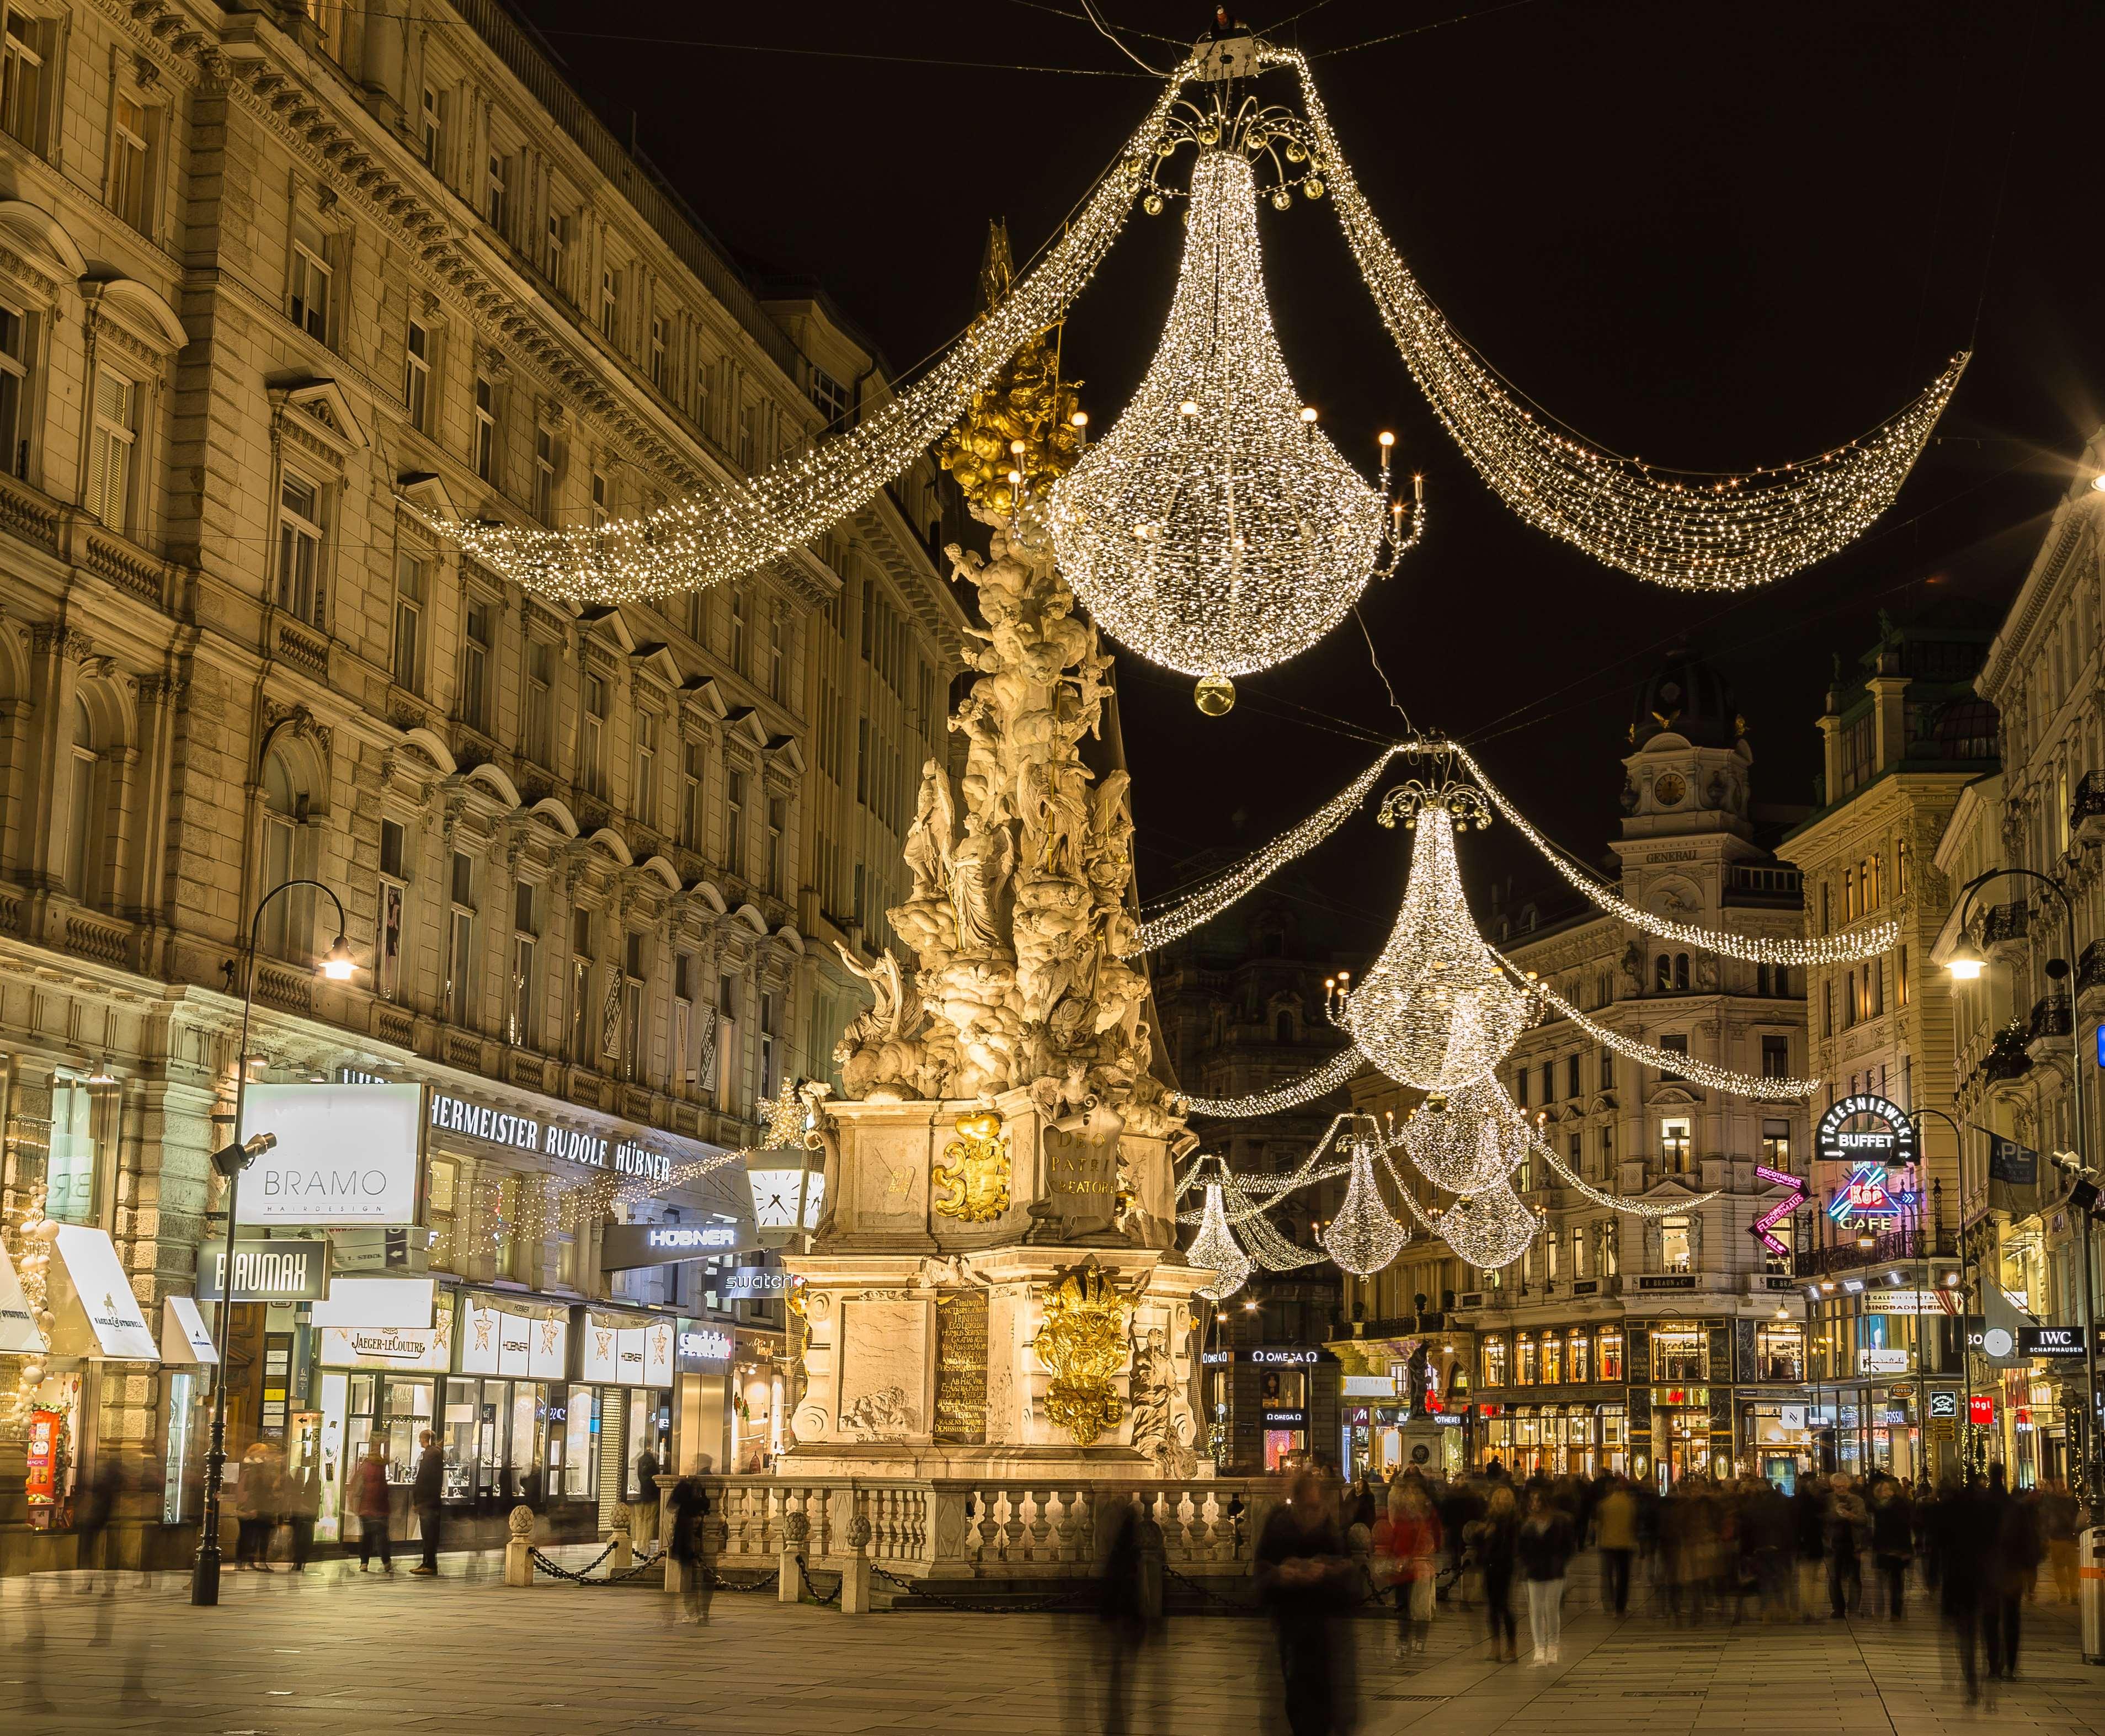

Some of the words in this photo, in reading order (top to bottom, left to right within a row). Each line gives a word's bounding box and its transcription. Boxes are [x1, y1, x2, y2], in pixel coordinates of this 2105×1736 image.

[1646, 850, 1697, 864] GENERALI
[1058, 1131, 1105, 1148] DEO
[1838, 1135, 1894, 1147] BUFFET
[546, 1126, 607, 1166] RUDOLF
[616, 1140, 670, 1182] HÜBNER
[1052, 1157, 1110, 1171] PATRI
[265, 1170, 386, 1195] BRAMO
[1757, 1167, 1802, 1185] DISCOTHEQUE
[1049, 1180, 1113, 1194] CREATORI
[1757, 1194, 1803, 1233] FLEDERMAUS
[1840, 1218, 1892, 1230] CAFE
[1765, 1234, 1778, 1247] BAR
[215, 1253, 307, 1291] BAUMAX
[726, 1273, 793, 1289] swatch
[2040, 1332, 2071, 1344] IWC
[1886, 1410, 1904, 1423] FOSSIL
